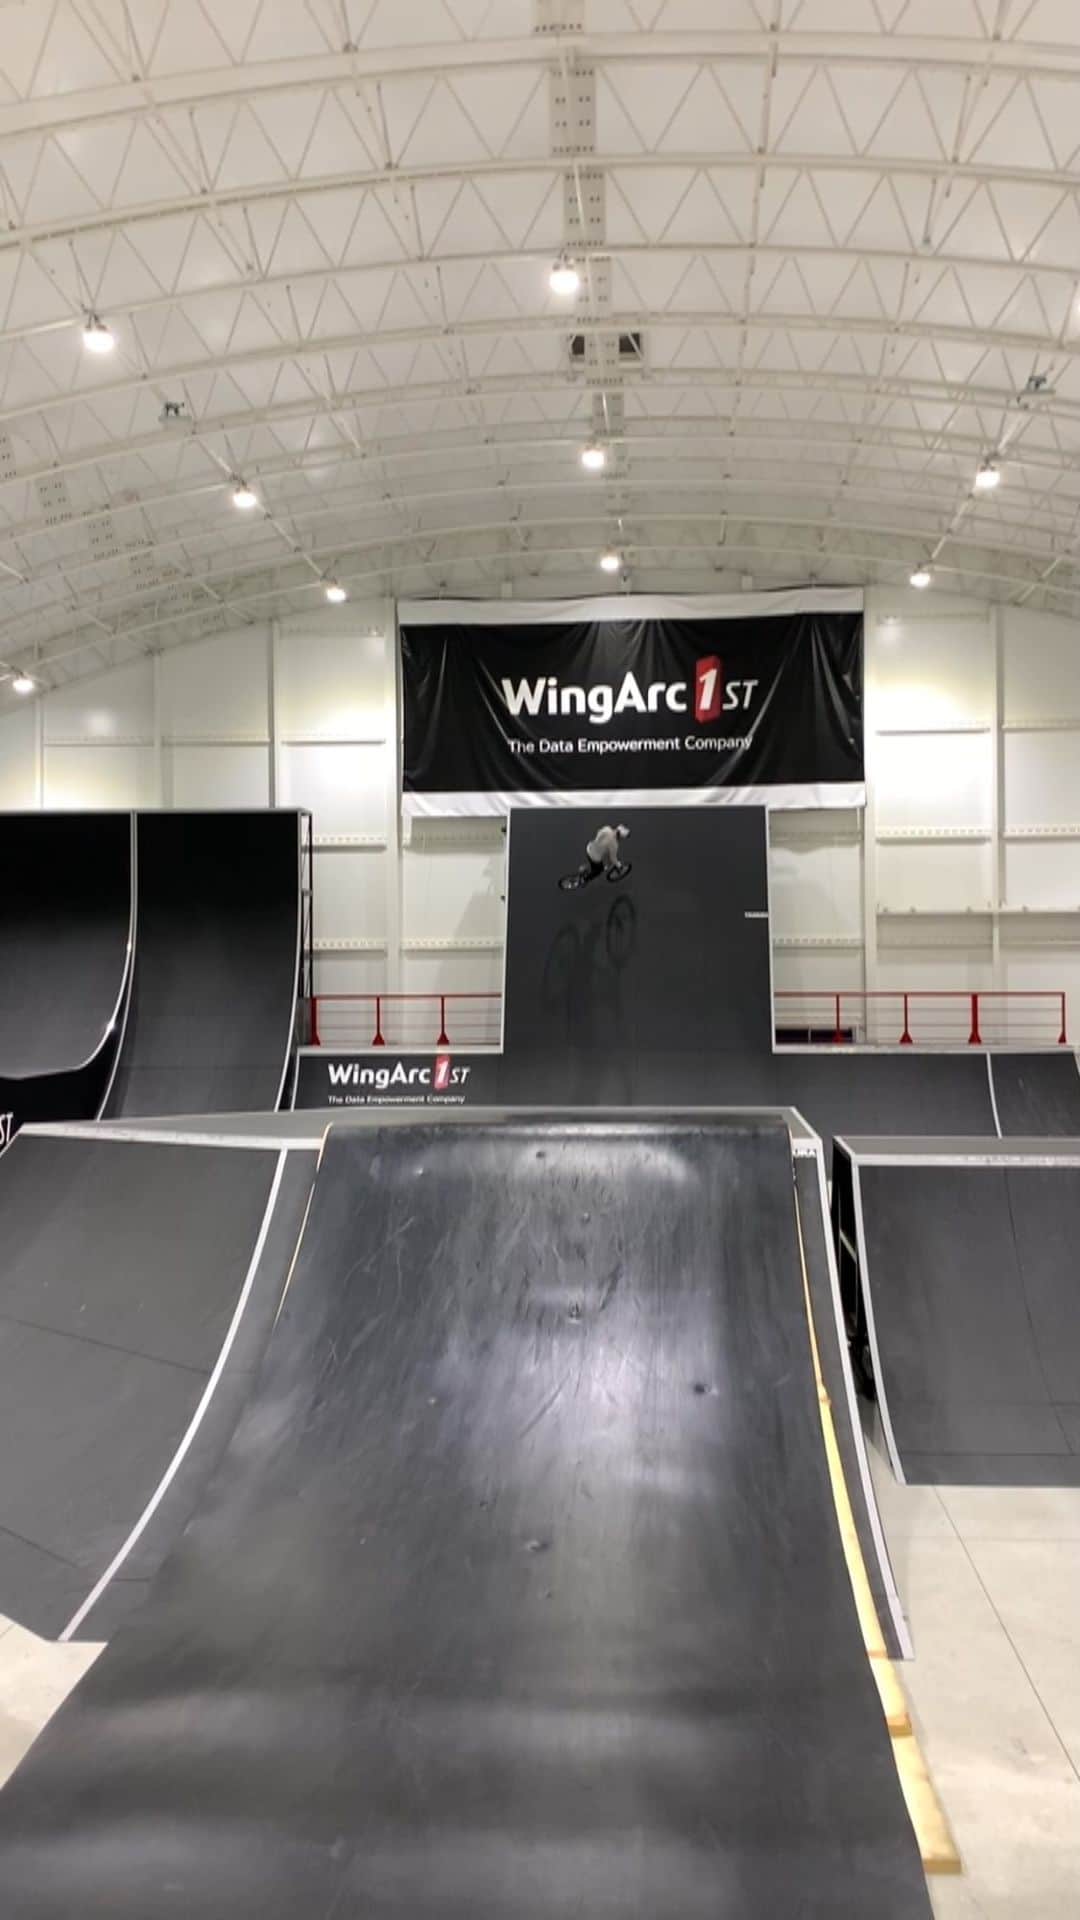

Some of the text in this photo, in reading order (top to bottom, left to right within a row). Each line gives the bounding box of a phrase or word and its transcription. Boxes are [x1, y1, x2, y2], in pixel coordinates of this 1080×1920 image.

[502, 671, 687, 724] WingArc
[509, 735, 753, 754] The Data Empowerment Company
[328, 1062, 431, 1089] WingArc
